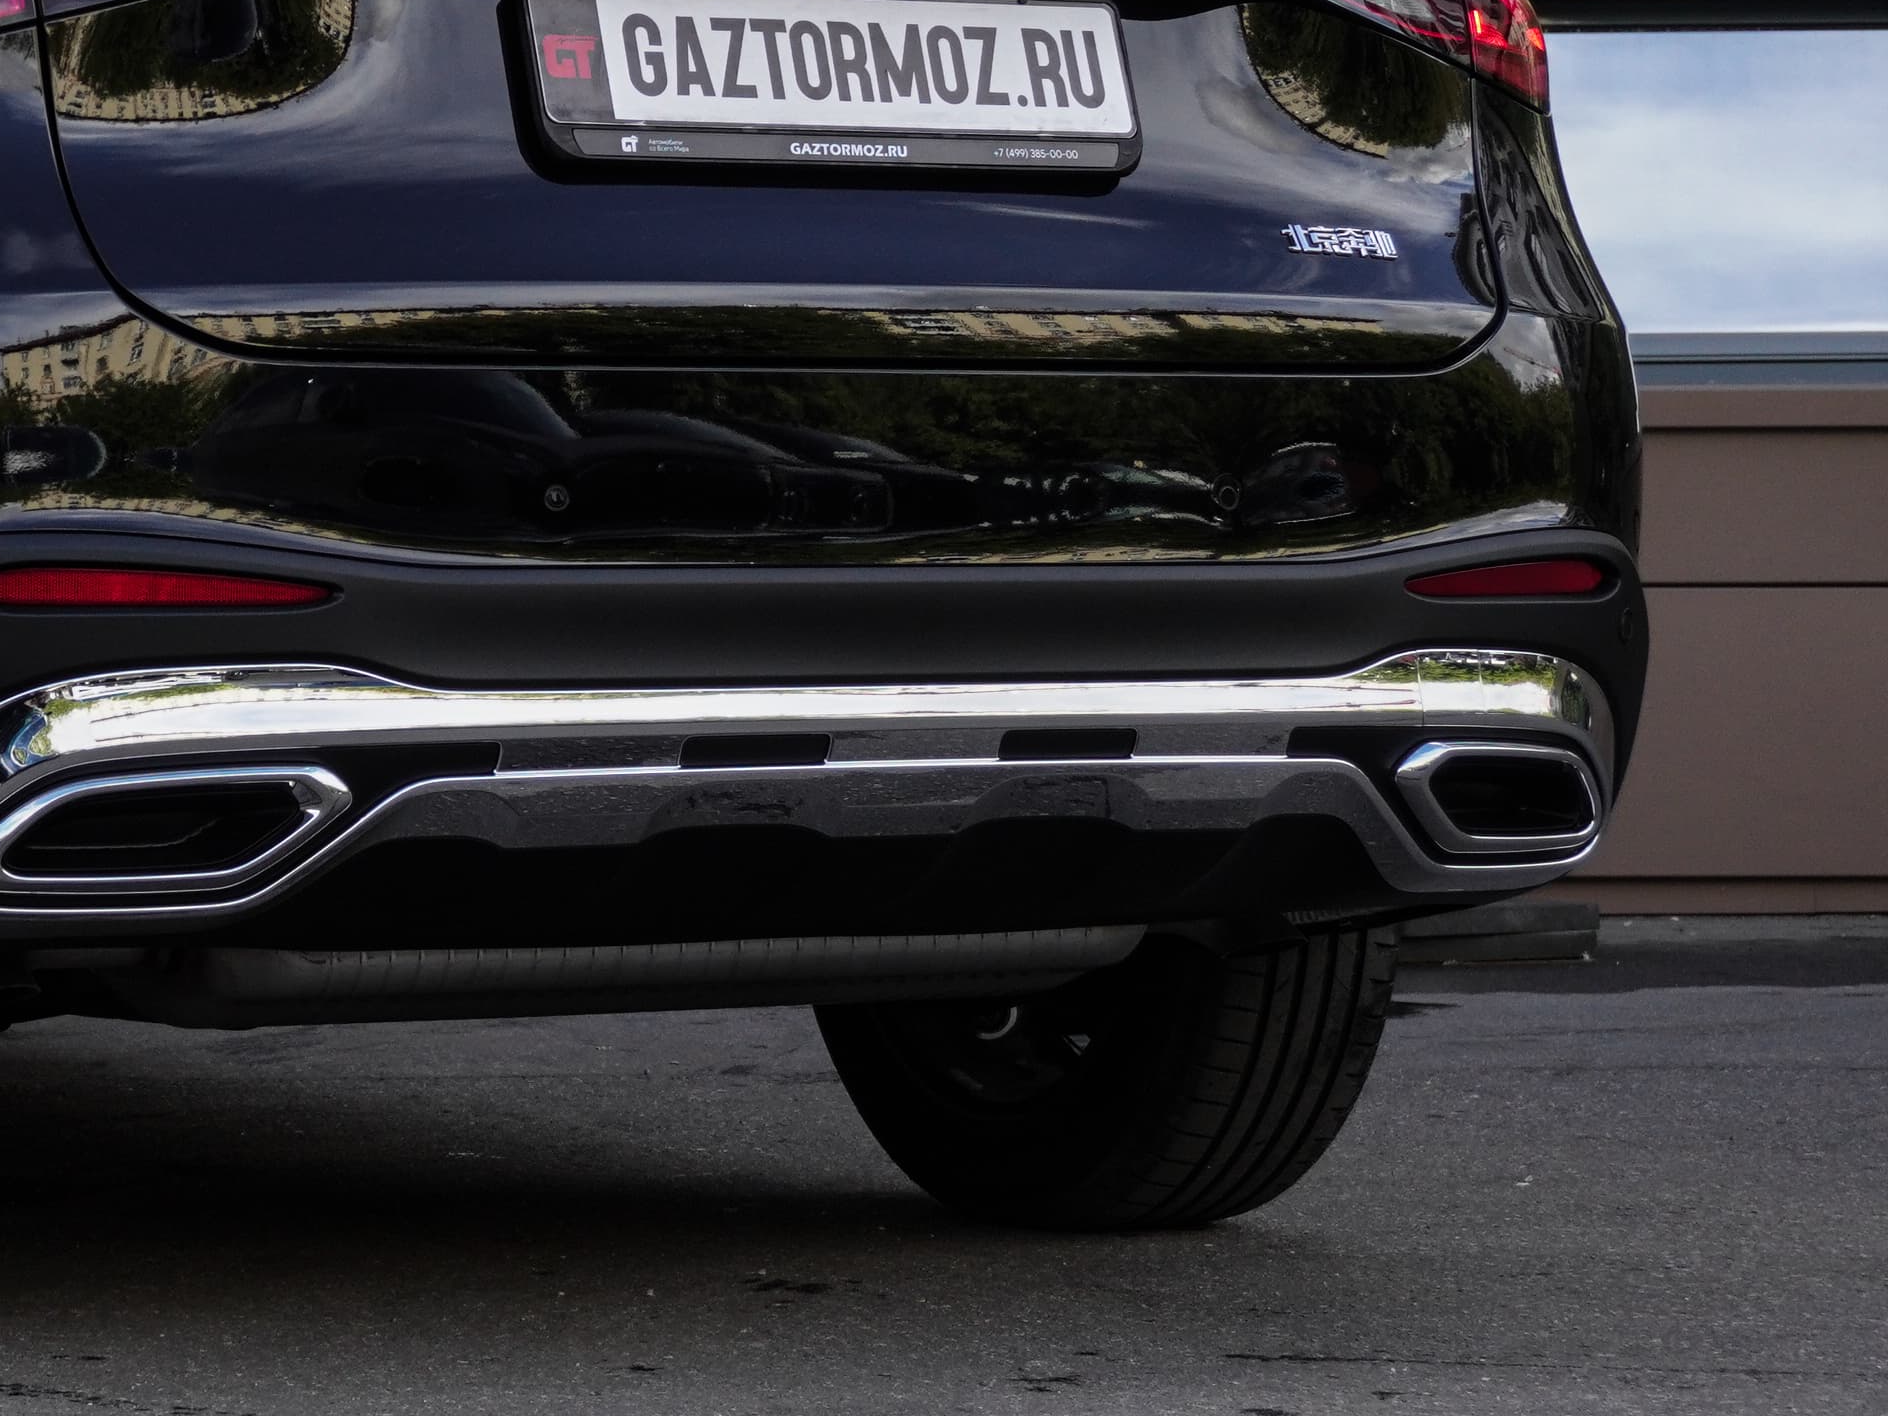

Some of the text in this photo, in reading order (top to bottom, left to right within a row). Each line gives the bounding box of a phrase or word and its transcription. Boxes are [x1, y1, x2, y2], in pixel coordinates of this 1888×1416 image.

[542, 33, 598, 79] GT
[621, 12, 1107, 110] GAZTORMOZ.RU
[790, 142, 907, 157] GAZTORMOZ.RU
[1005, 148, 1029, 159] (499)
[1280, 224, 1399, 259] 北京奔驰
